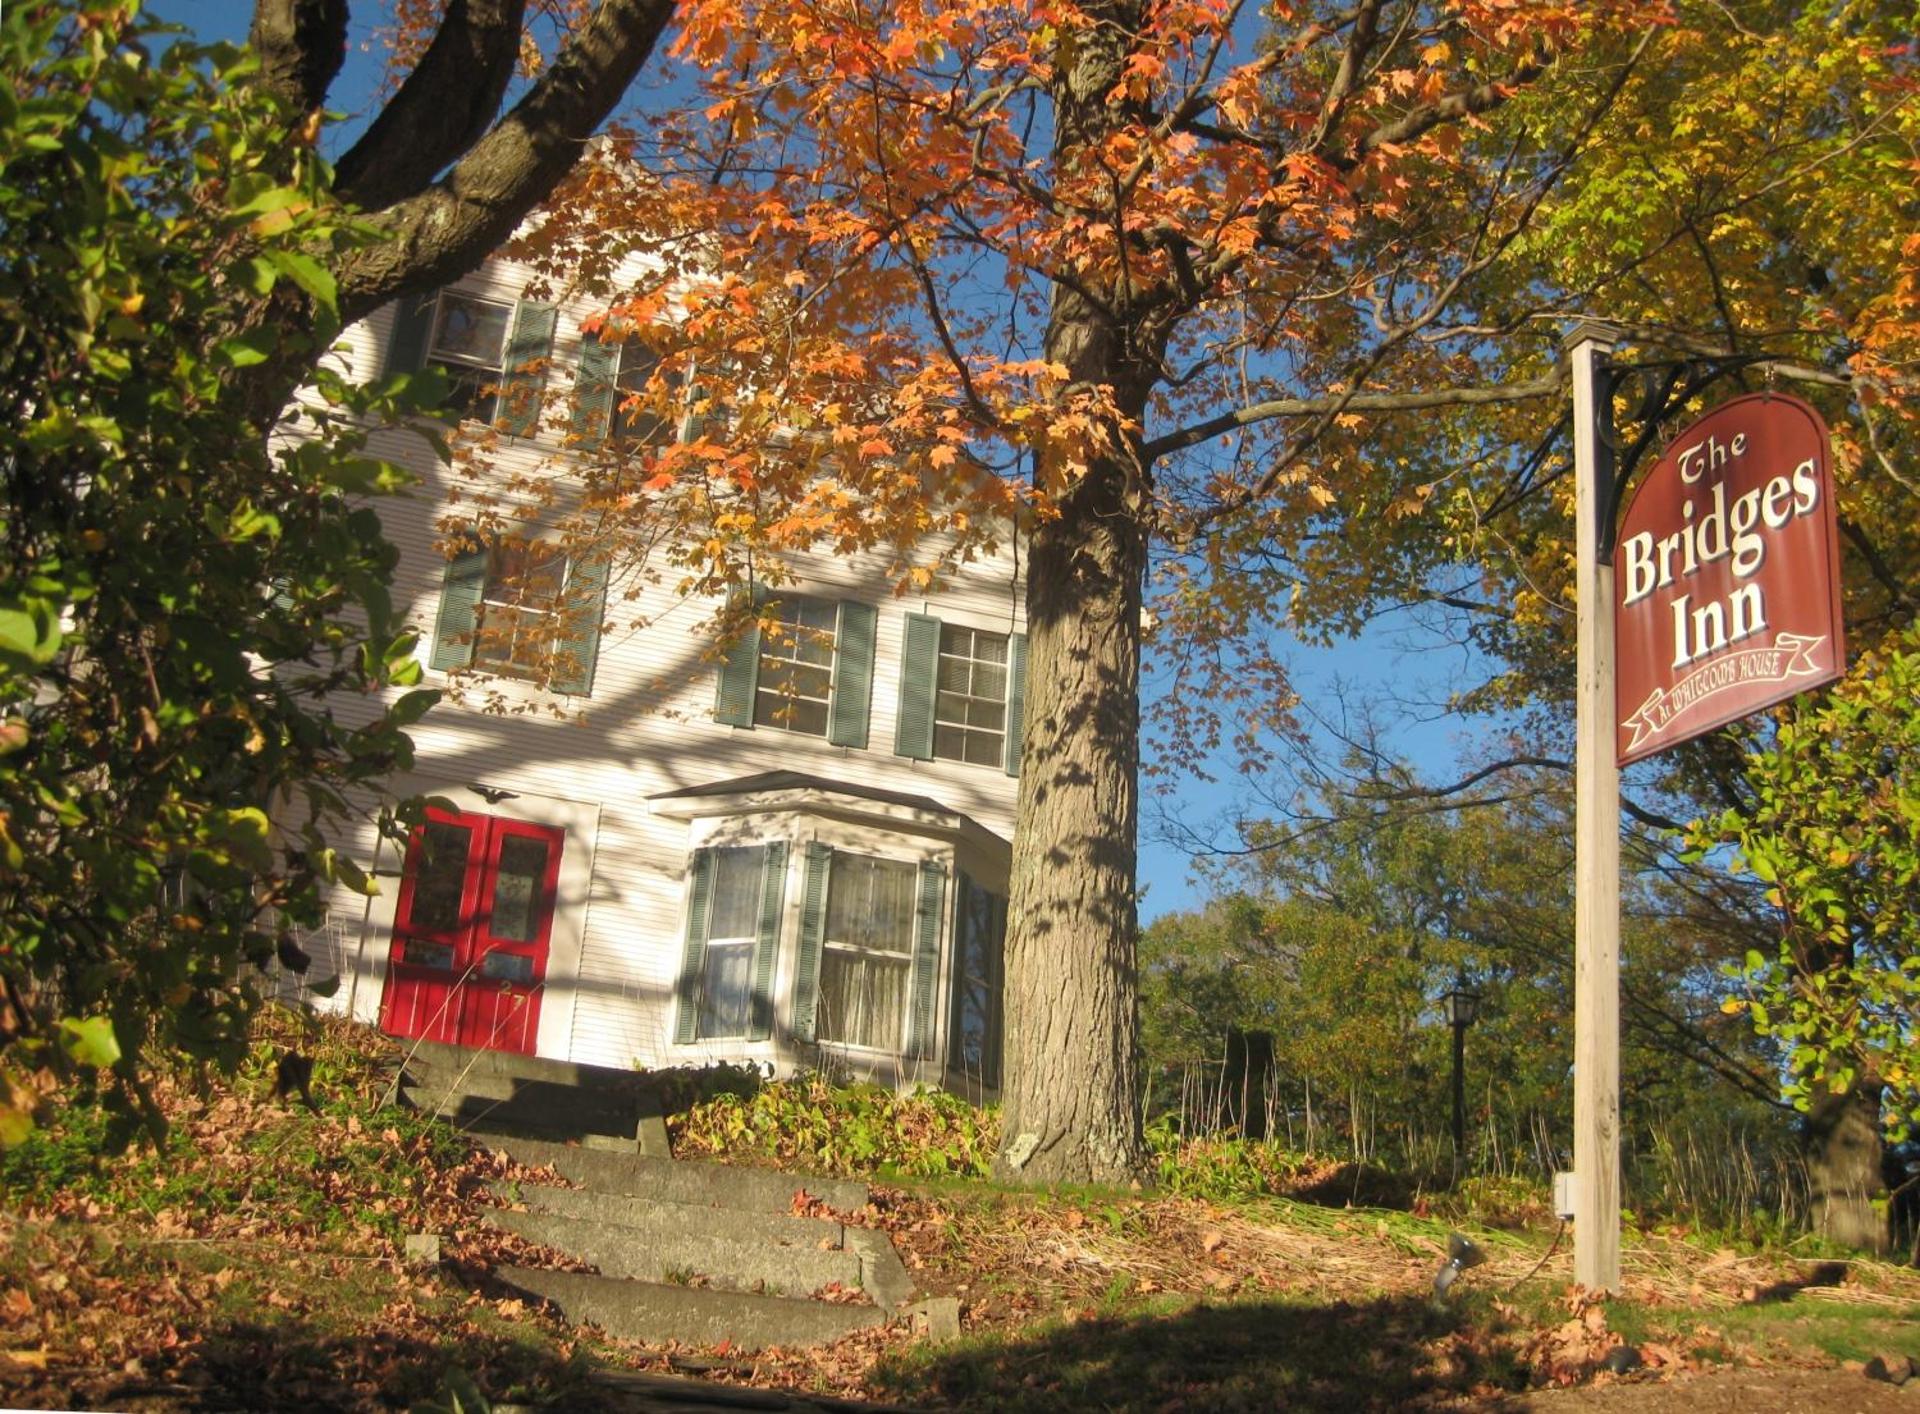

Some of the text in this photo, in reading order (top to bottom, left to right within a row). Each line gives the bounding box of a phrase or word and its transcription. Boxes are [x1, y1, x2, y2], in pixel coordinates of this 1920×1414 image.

[1677, 432, 1747, 484] The
[1622, 458, 1819, 606] Bridges
[1671, 581, 1767, 668] Inn
[1739, 652, 1781, 679] HOUSE
[499, 980, 526, 1010] 27
